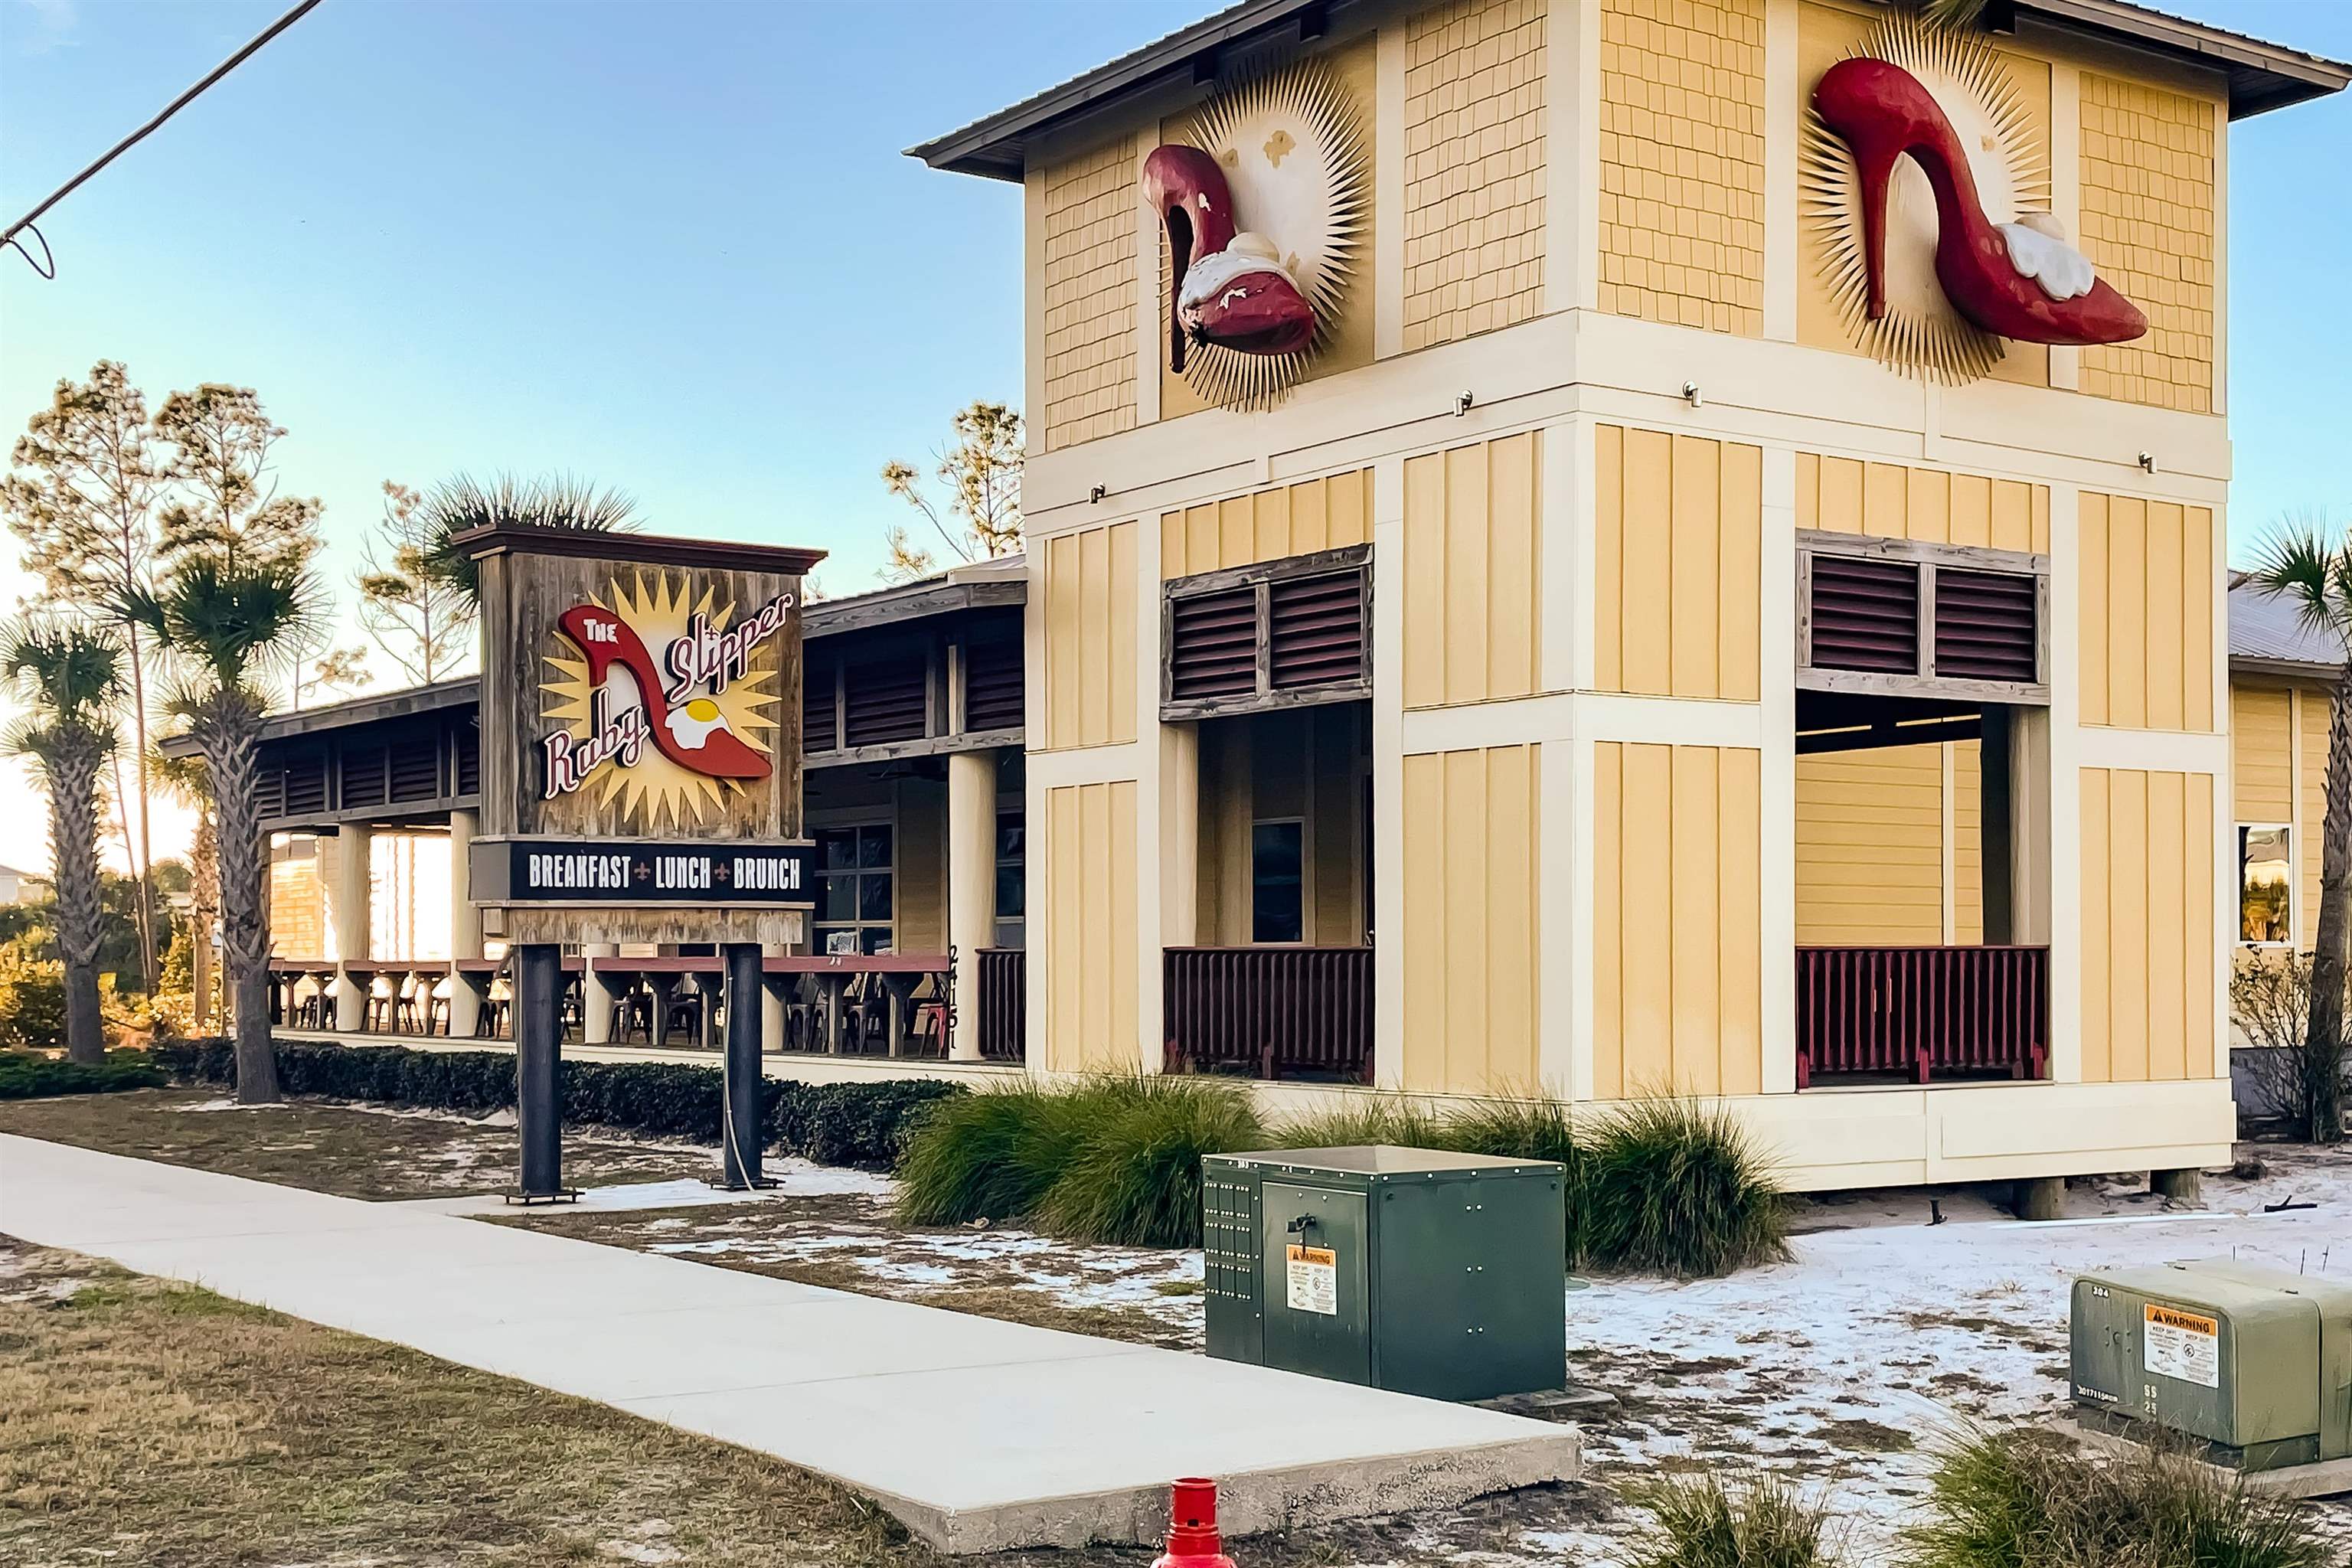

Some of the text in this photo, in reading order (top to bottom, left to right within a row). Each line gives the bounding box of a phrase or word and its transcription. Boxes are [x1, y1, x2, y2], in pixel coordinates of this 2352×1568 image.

[583, 619, 619, 645] THE
[544, 593, 794, 799] Ruby Slipper
[529, 854, 800, 890] BREAKFAST LUNCH BRUNCH
[2164, 1312, 2210, 1333] WARNING
